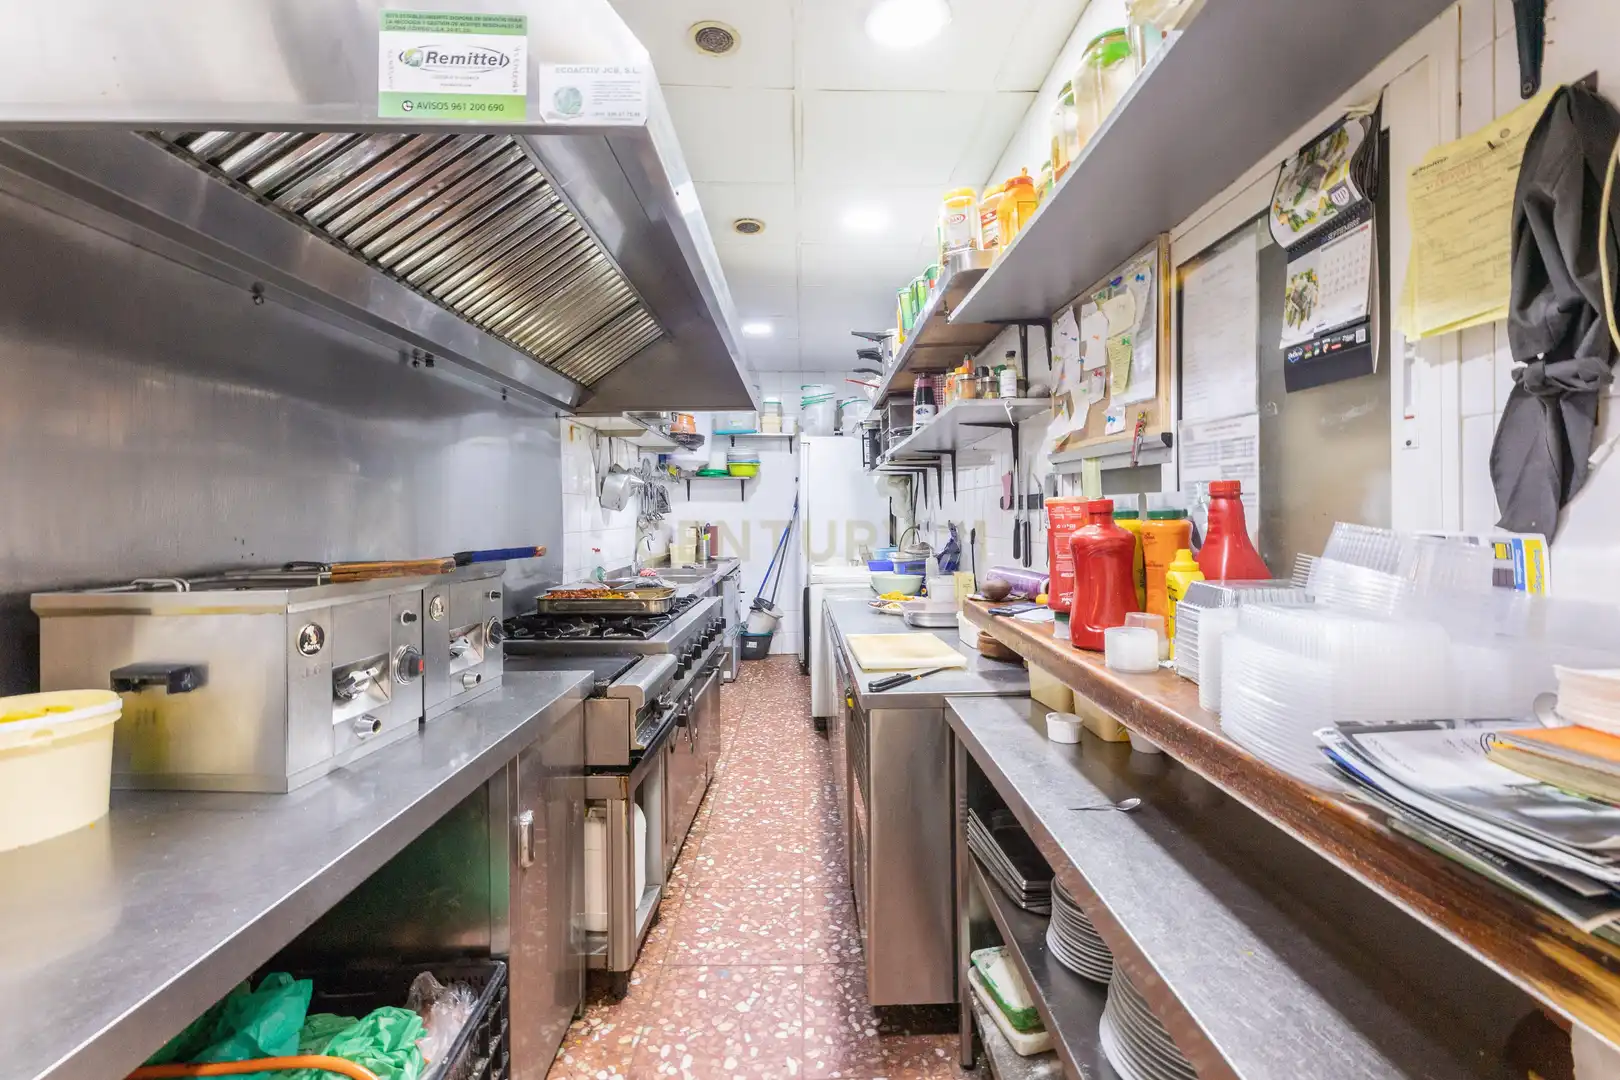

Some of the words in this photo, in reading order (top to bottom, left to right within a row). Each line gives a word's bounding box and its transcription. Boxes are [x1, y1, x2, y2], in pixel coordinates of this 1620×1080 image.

[425, 51, 504, 66] Remittel
[416, 102, 449, 110] AVISOS
[450, 102, 467, 110] 961
[469, 103, 486, 111] 200
[487, 103, 505, 112] 690
